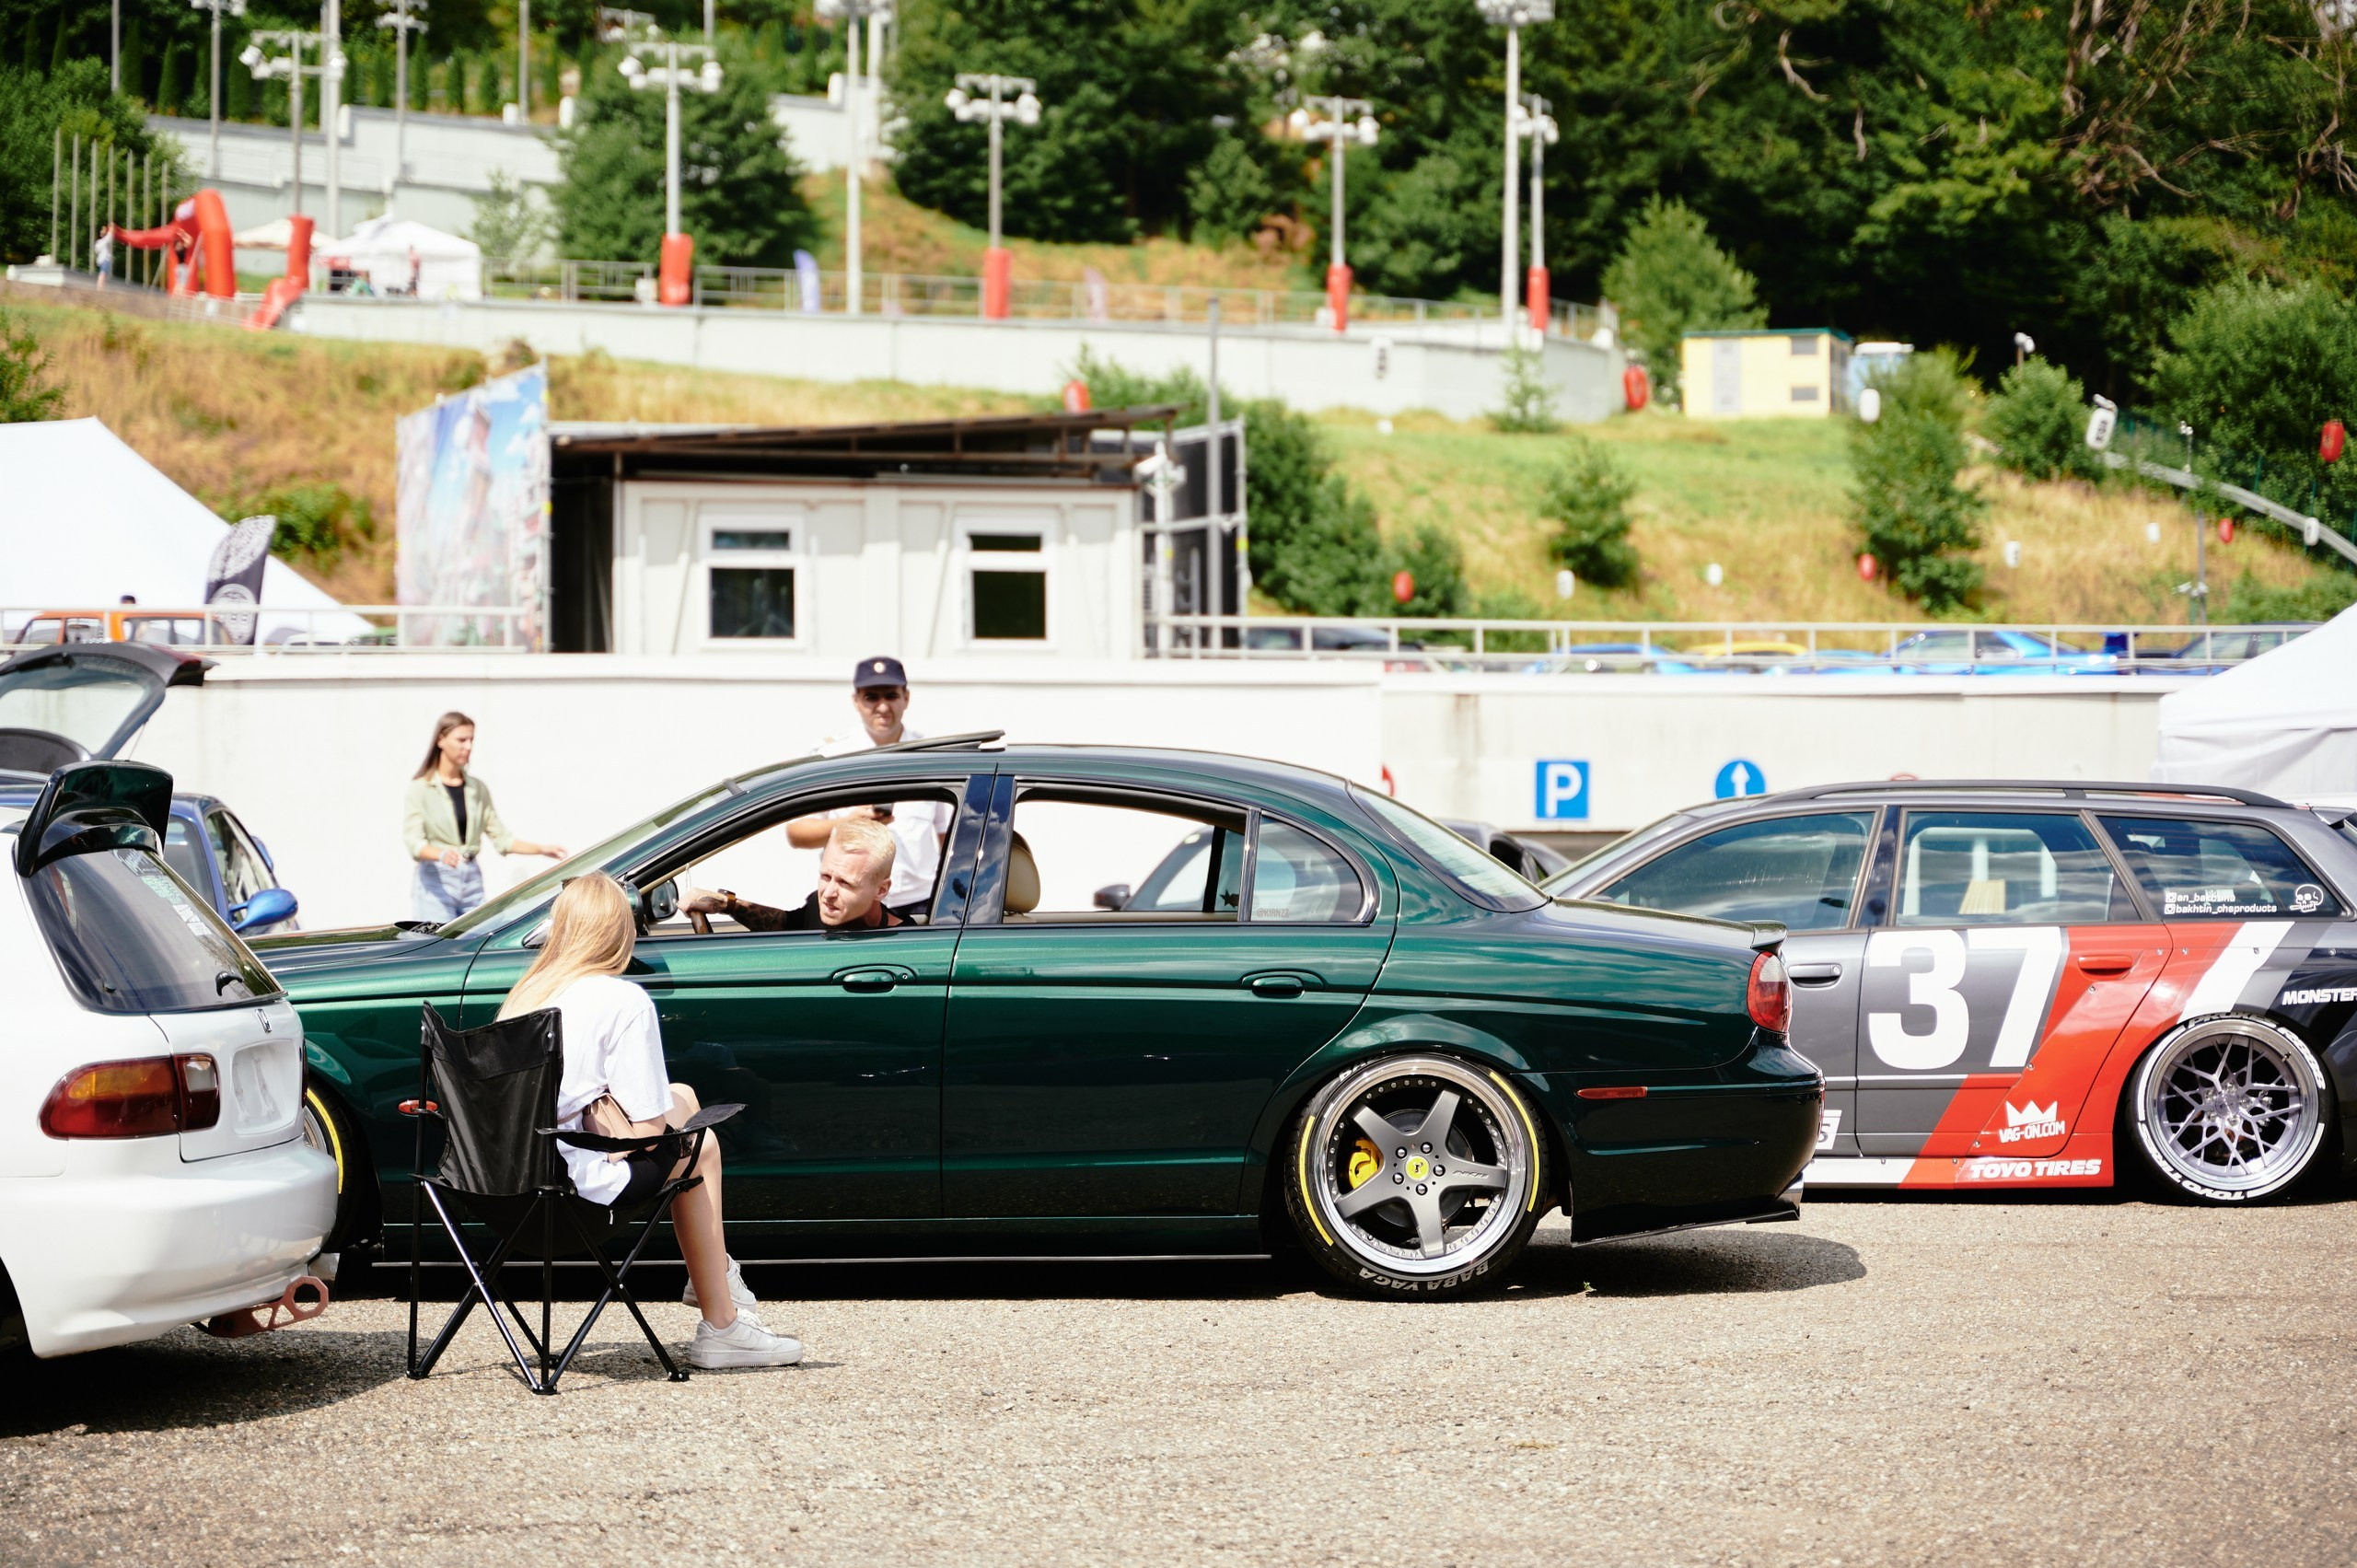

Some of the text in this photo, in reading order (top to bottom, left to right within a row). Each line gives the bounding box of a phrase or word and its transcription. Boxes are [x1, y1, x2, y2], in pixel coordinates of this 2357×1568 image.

[1545, 763, 1583, 818] P
[1868, 926, 2062, 1070] 37
[1999, 1121, 2066, 1144] VAG-ON.COM
[1970, 1159, 2102, 1179] TOYO TIRES
[2181, 1180, 2246, 1201] TOYO
[1358, 1260, 1490, 1291] BABA YAGA
